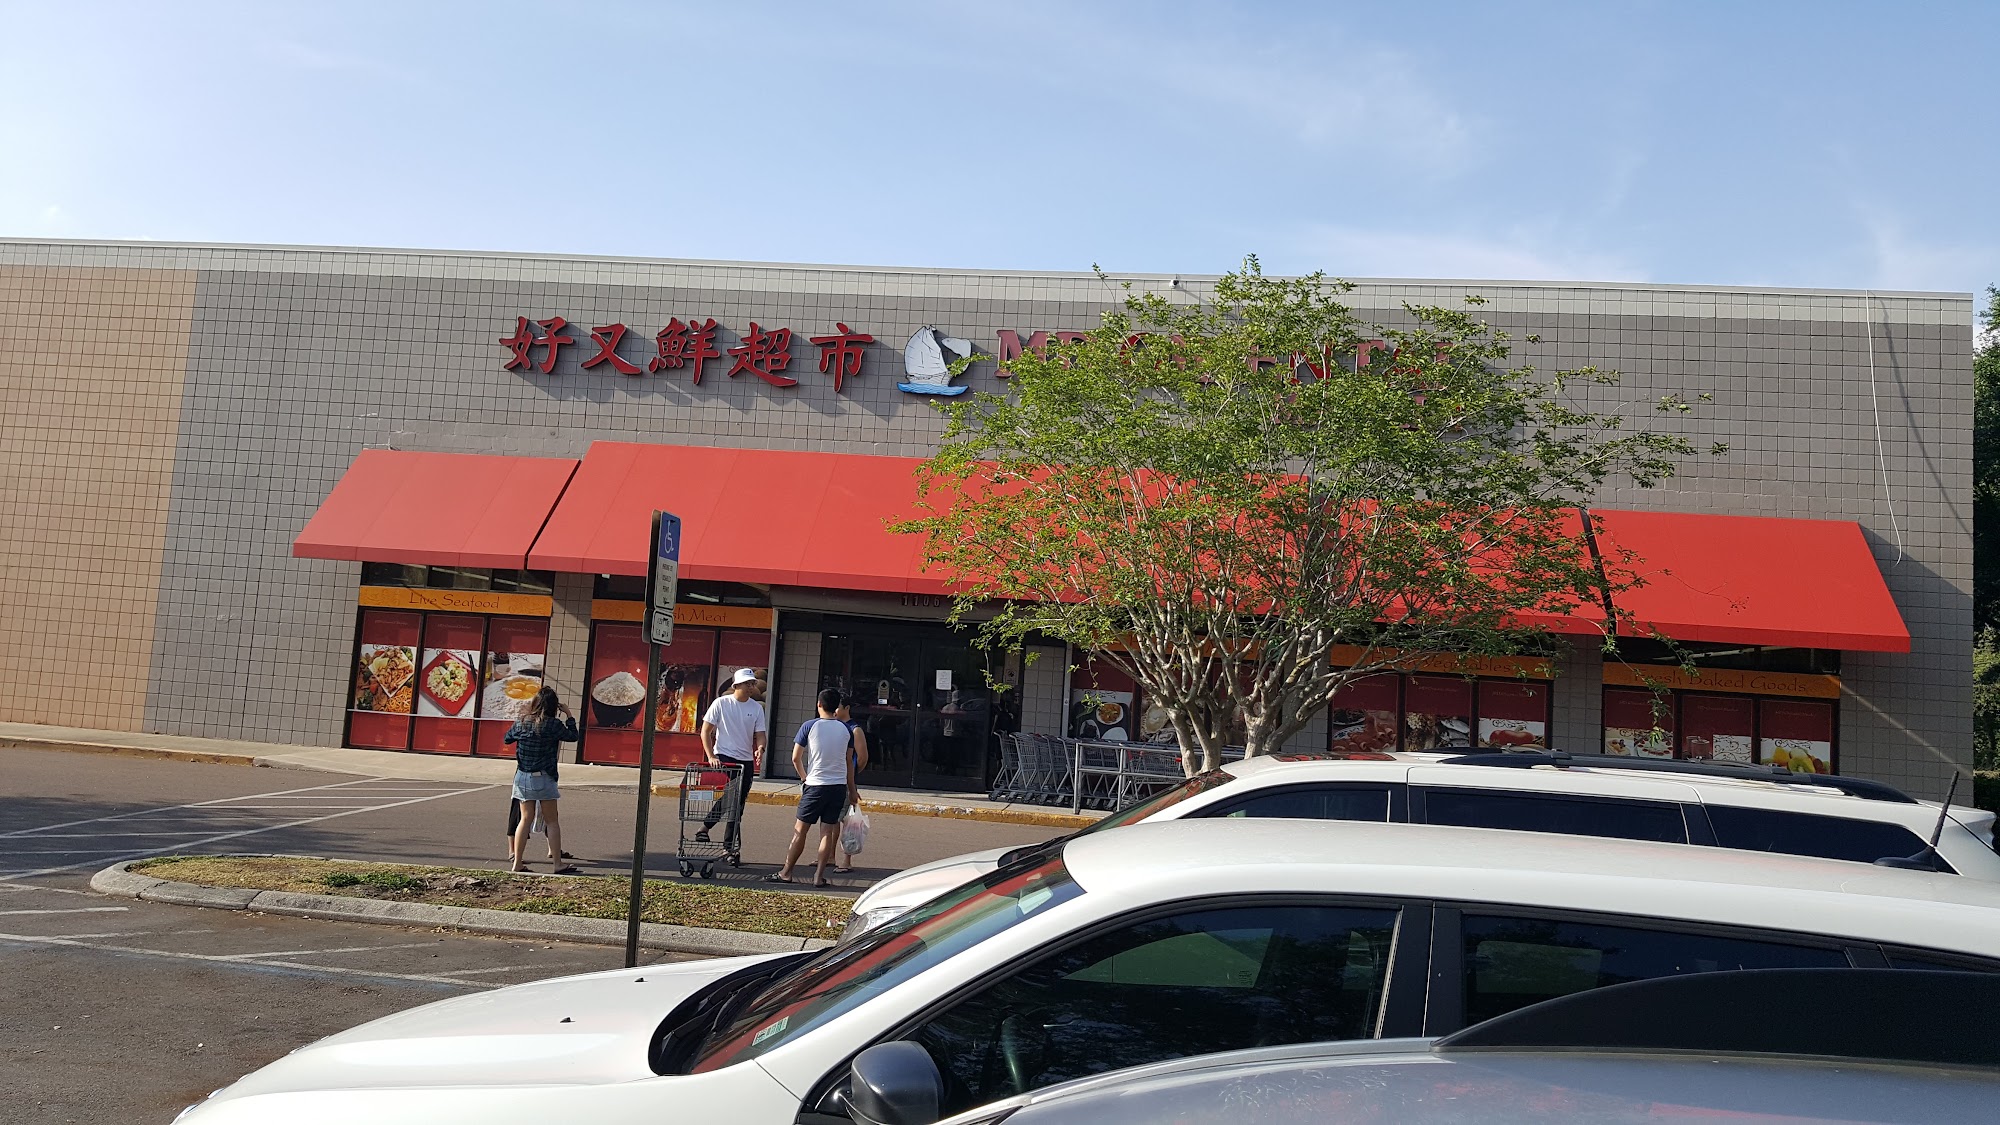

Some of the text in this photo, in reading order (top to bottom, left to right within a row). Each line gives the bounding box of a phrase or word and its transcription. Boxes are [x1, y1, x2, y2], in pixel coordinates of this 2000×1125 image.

[499, 316, 874, 393] 好又鮮超市
[408, 592, 500, 611] Live Seafood
[902, 595, 940, 607] 1106
[688, 608, 728, 623] Meat
[1423, 654, 1512, 673] Vegables
[1750, 675, 1807, 692] Goods
